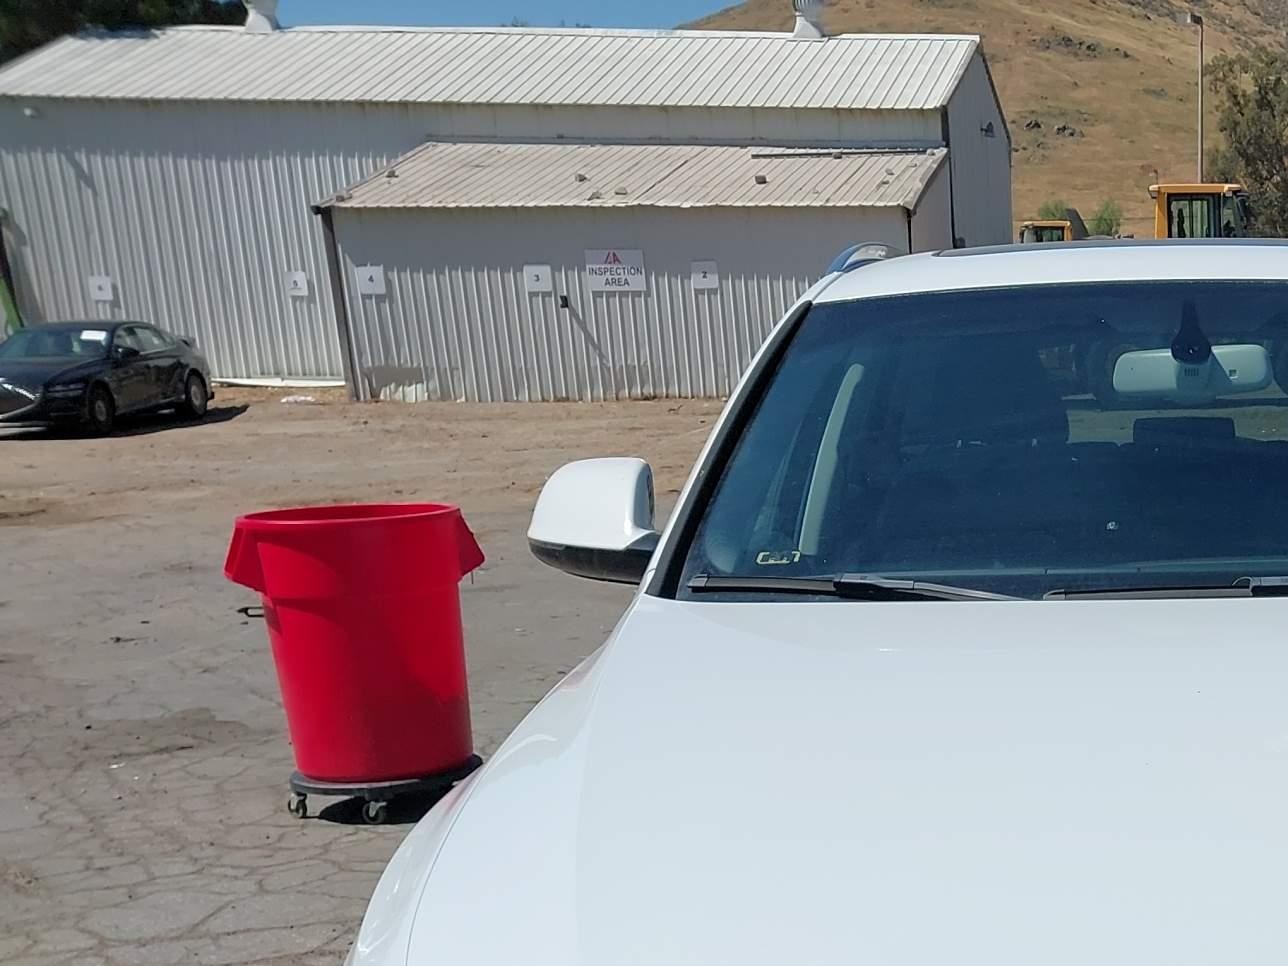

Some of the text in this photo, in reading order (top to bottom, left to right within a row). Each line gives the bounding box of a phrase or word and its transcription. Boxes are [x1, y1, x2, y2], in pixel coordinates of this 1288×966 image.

[588, 266, 643, 276] INSPECTION
[701, 271, 708, 279] 2
[604, 277, 630, 287] AREA
